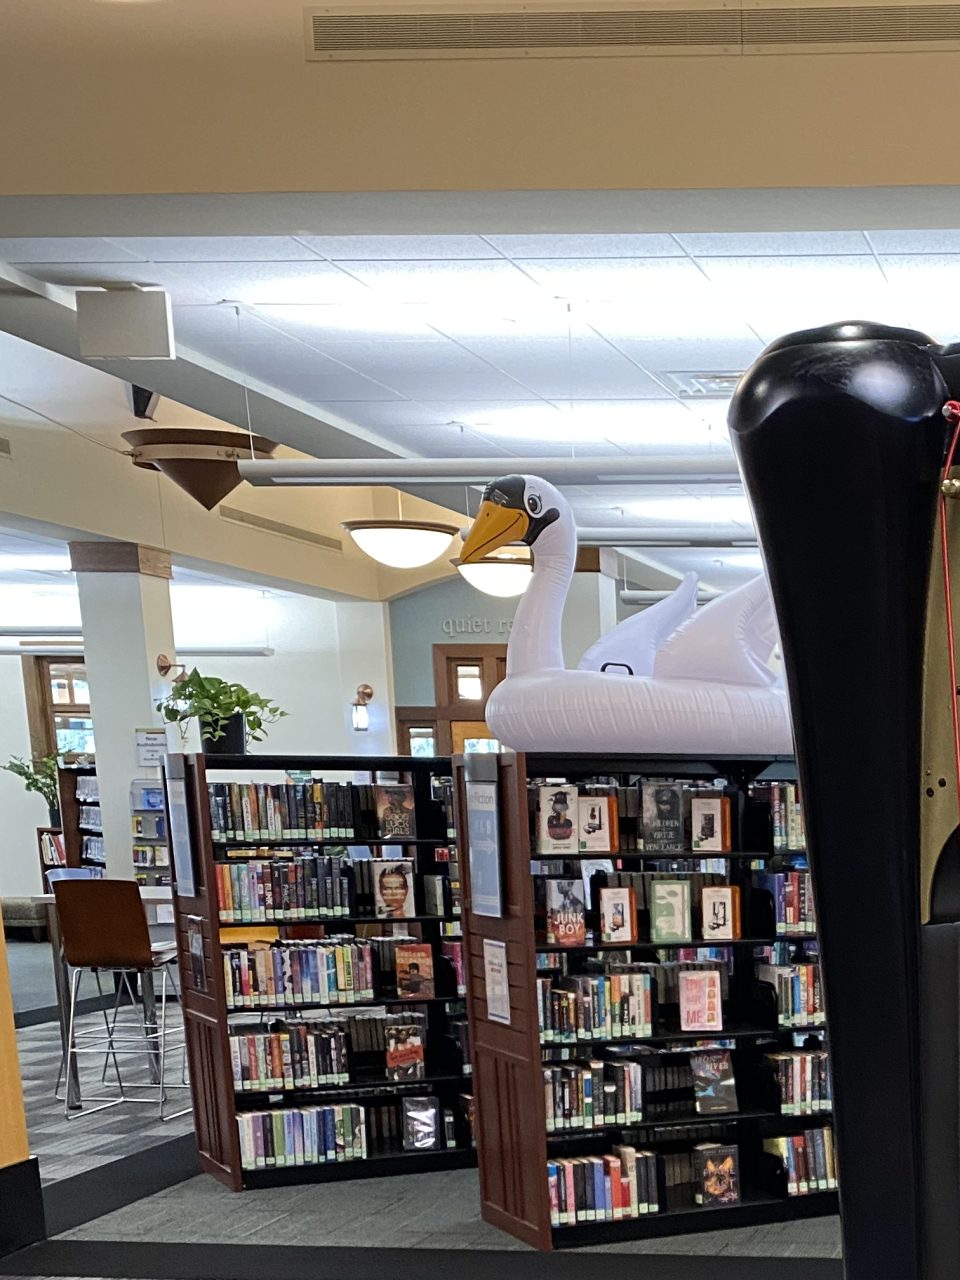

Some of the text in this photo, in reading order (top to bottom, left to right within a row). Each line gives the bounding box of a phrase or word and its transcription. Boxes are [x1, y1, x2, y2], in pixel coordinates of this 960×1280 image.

[442, 614, 491, 637] quiet
[554, 912, 585, 924] JUNK
[559, 924, 581, 935] BOY
